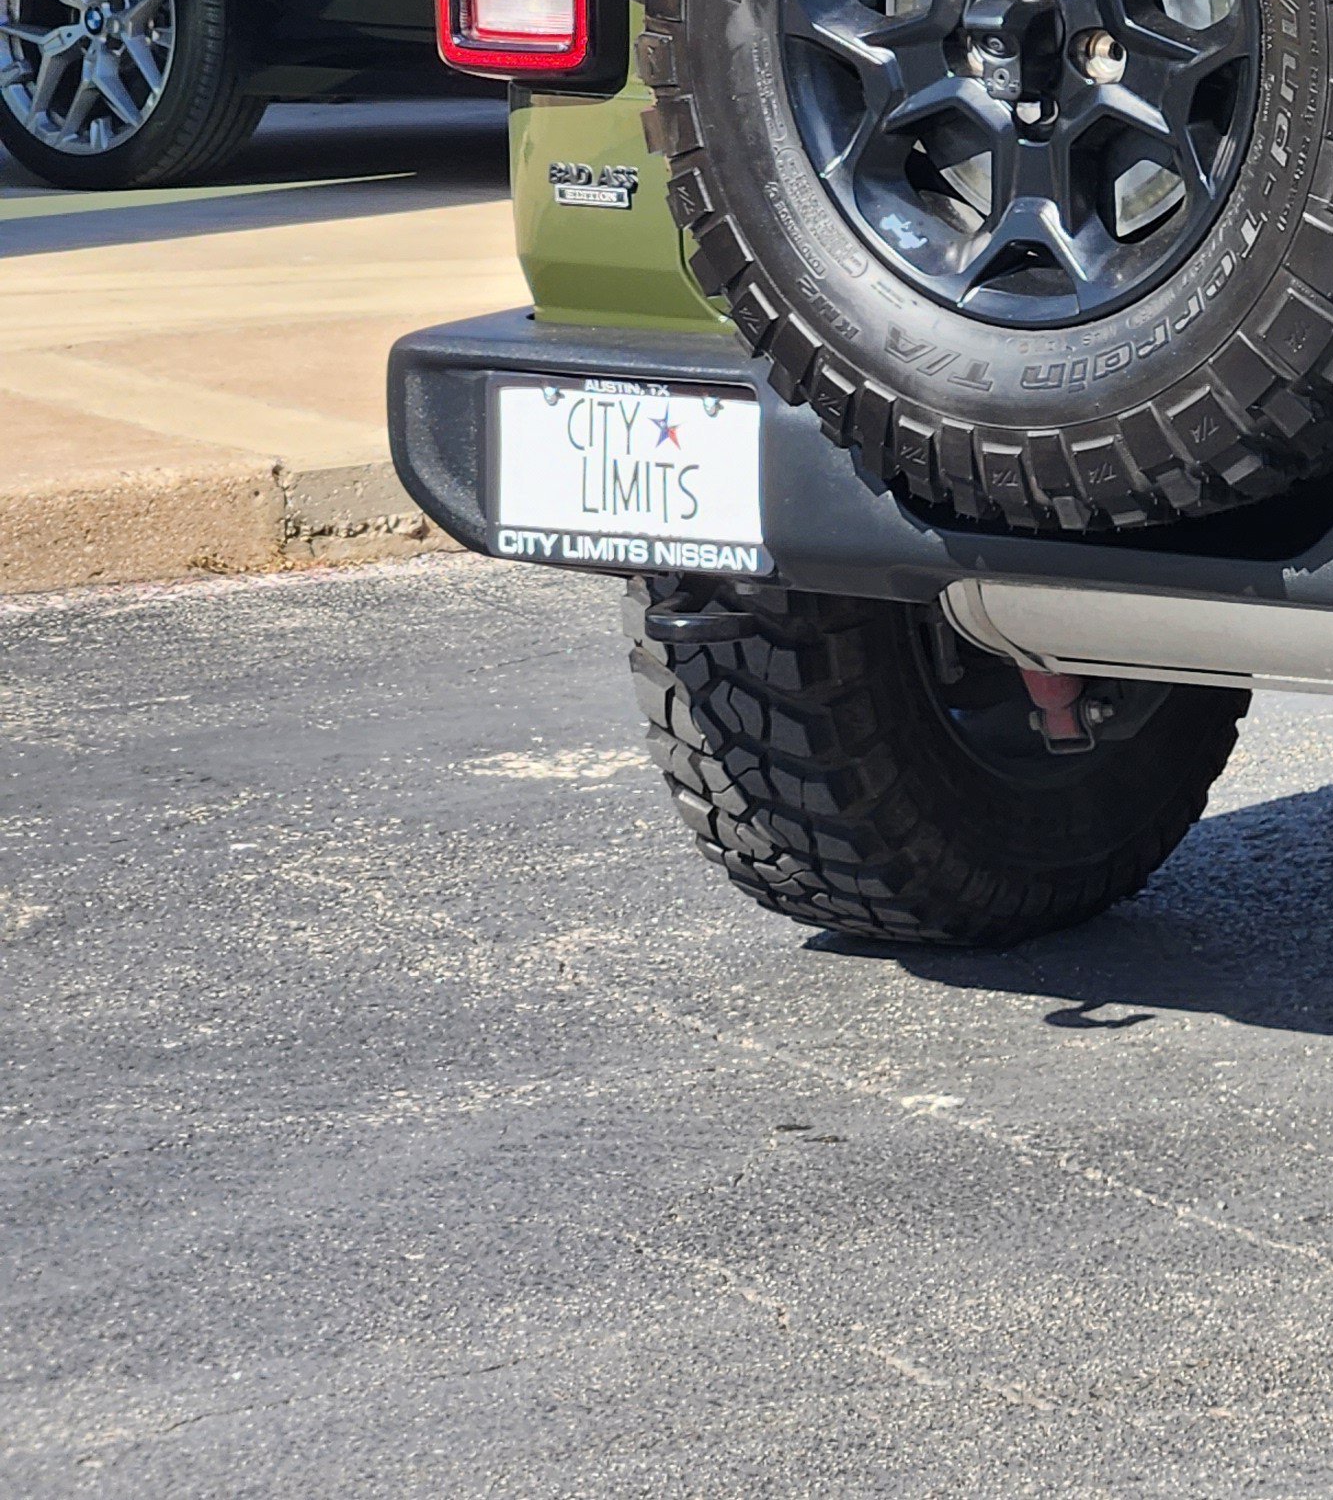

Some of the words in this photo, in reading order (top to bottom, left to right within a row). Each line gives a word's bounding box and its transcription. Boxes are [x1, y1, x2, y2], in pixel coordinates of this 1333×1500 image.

[549, 161, 594, 186] BAD
[598, 164, 639, 190] ASS
[564, 188, 619, 202] EDITION
[796, 273, 863, 340] KM2
[647, 383, 672, 398] TX
[567, 397, 642, 485] CITY
[581, 455, 700, 523] LIMITS
[498, 529, 560, 556] CITY
[562, 533, 651, 564] LIMITS
[653, 541, 758, 573] NISSAN
